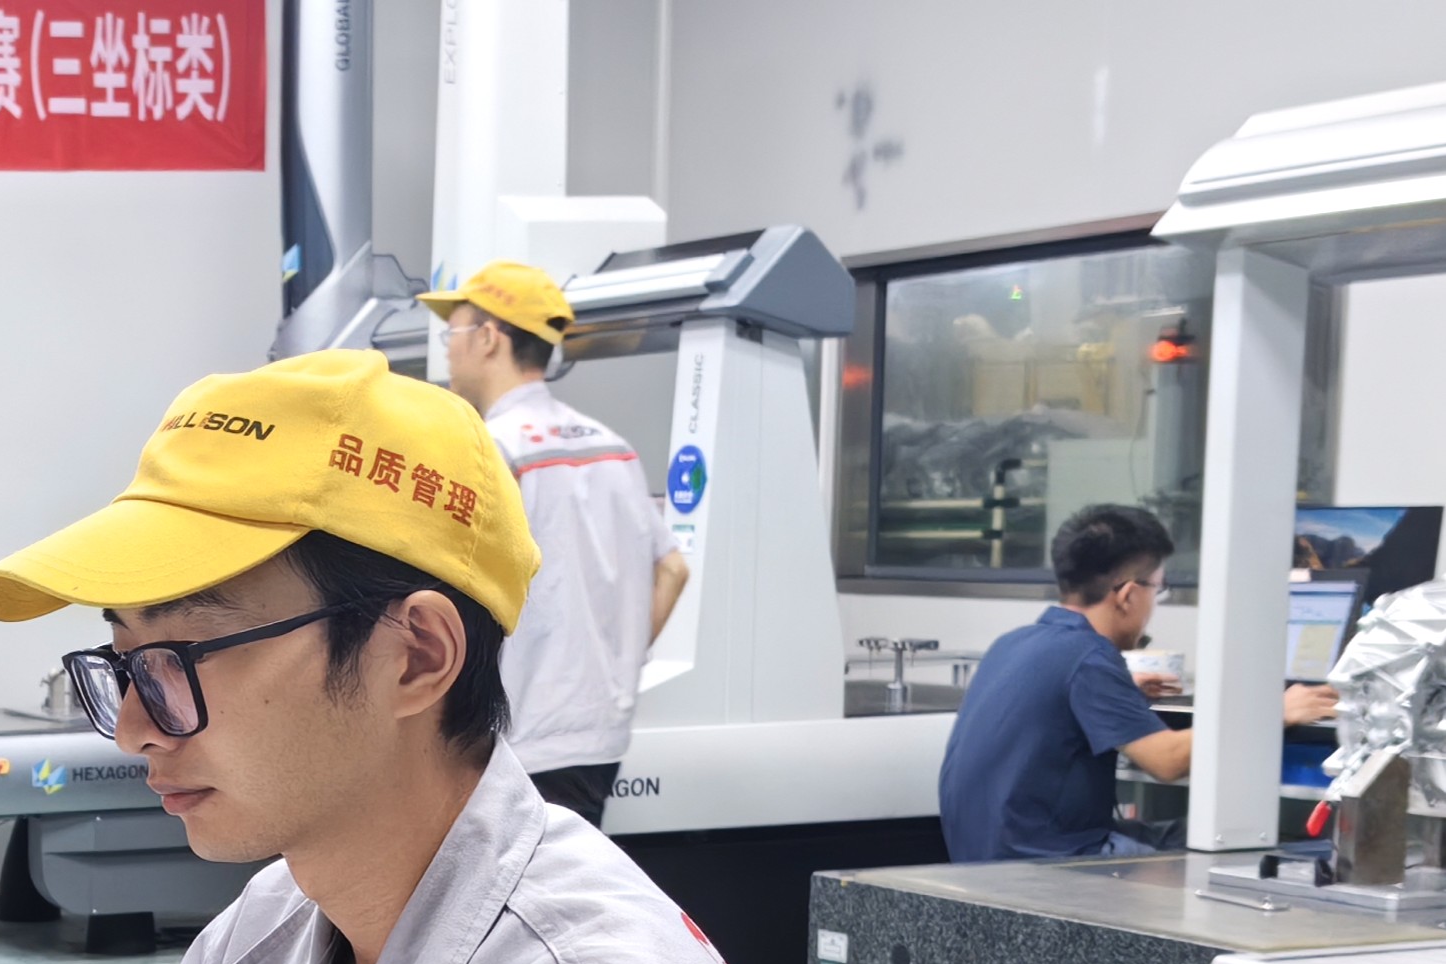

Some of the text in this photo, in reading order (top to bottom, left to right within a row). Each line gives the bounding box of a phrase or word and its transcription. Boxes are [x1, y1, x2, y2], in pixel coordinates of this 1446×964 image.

[328, 433, 478, 528] 品质管理
[72, 764, 149, 782] HEXAGON
[610, 777, 660, 798] GON
